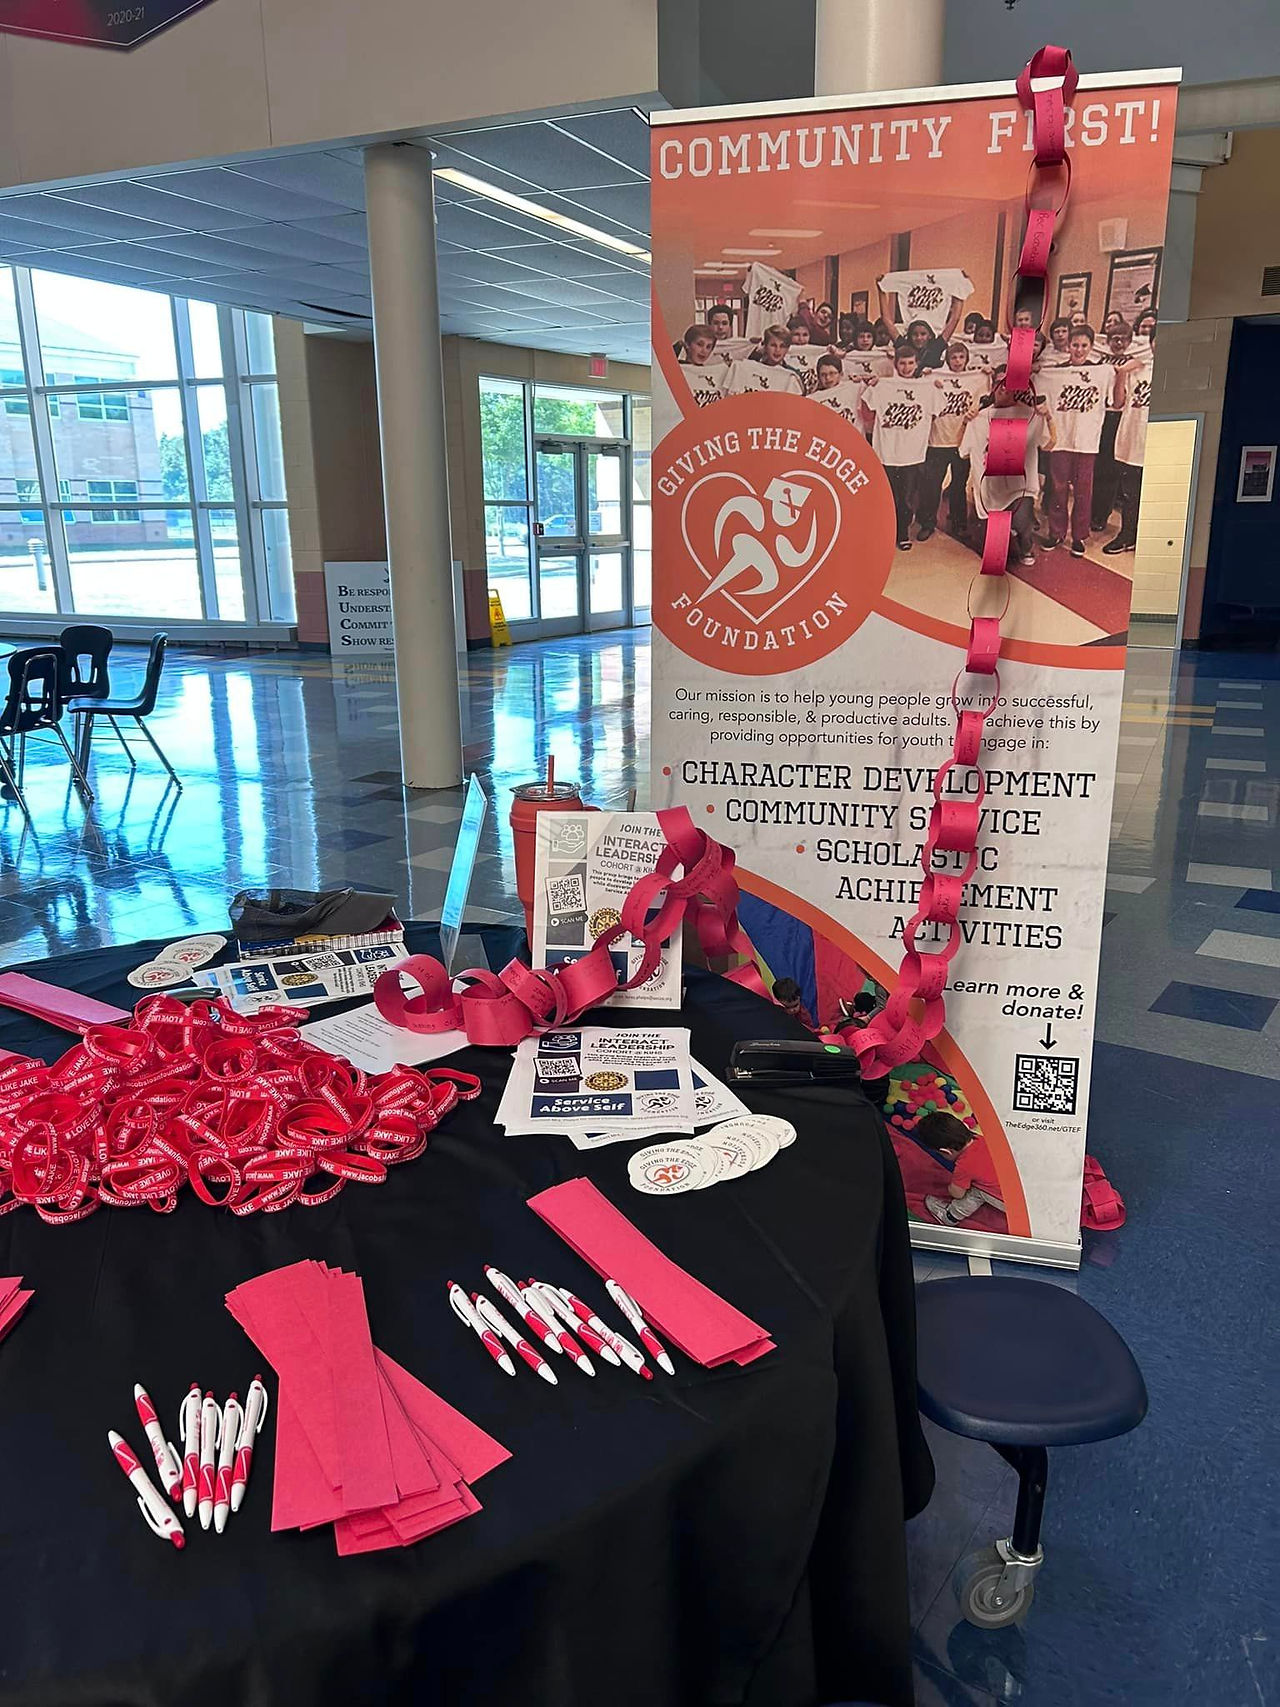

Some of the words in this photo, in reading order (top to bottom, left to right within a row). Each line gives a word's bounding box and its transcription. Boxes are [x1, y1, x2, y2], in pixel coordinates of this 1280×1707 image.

[107, 6, 145, 26] 2020-21
[660, 116, 952, 179] COMMUNITY
[657, 430, 741, 496] GIVING
[748, 427, 801, 451] THE
[805, 437, 870, 495] EDGE
[358, 588, 390, 596] RESPO
[340, 602, 391, 613] UNDERST
[341, 619, 388, 629] COMMIT
[671, 592, 849, 651] FOUNDATION
[342, 635, 377, 646] SHOW
[675, 688, 700, 701] Our
[706, 689, 755, 702] mission
[760, 691, 770, 703] is
[775, 692, 789, 703] to
[794, 690, 824, 706] help
[829, 694, 873, 708] young
[879, 692, 930, 709] people
[936, 697, 973, 709] grow
[1012, 694, 1093, 710] successful,
[669, 709, 714, 724] caring,
[719, 710, 801, 725] responsible,
[806, 711, 816, 723] &
[822, 712, 897, 727] productive
[902, 713, 950, 726] adults.
[986, 714, 1044, 728] achieve
[1049, 716, 1075, 728] this
[1082, 716, 1100, 732] by
[711, 729, 774, 745] providing
[779, 731, 873, 746] opportunities
[878, 733, 898, 745] for
[902, 734, 943, 749] youth
[982, 737, 1026, 751] ngage
[1032, 736, 1049, 749] in:
[683, 760, 851, 789] CHARACTER
[863, 766, 1096, 797] DEVELOPMENT
[726, 799, 898, 829] COMMUNITY
[910, 808, 1041, 835] SICE
[620, 824, 641, 834] JOIN
[644, 827, 661, 837] THE
[603, 835, 668, 852] INTERACT
[596, 846, 659, 864] LEADERSH
[816, 839, 998, 871] SCHOLASTC
[600, 862, 633, 871] COHORT
[836, 876, 1058, 912] ACHIEMENT
[889, 916, 1062, 949] ATVITIES
[1007, 984, 1060, 998] more
[1068, 984, 1085, 1000] &
[1002, 1000, 1084, 1019] donate!
[554, 1097, 610, 1106] Service
[594, 1103, 626, 1111] Self
[311, 1137, 329, 1145] JAKE
[640, 1158, 664, 1170] GIVING
[282, 1169, 304, 1179] JAKE
